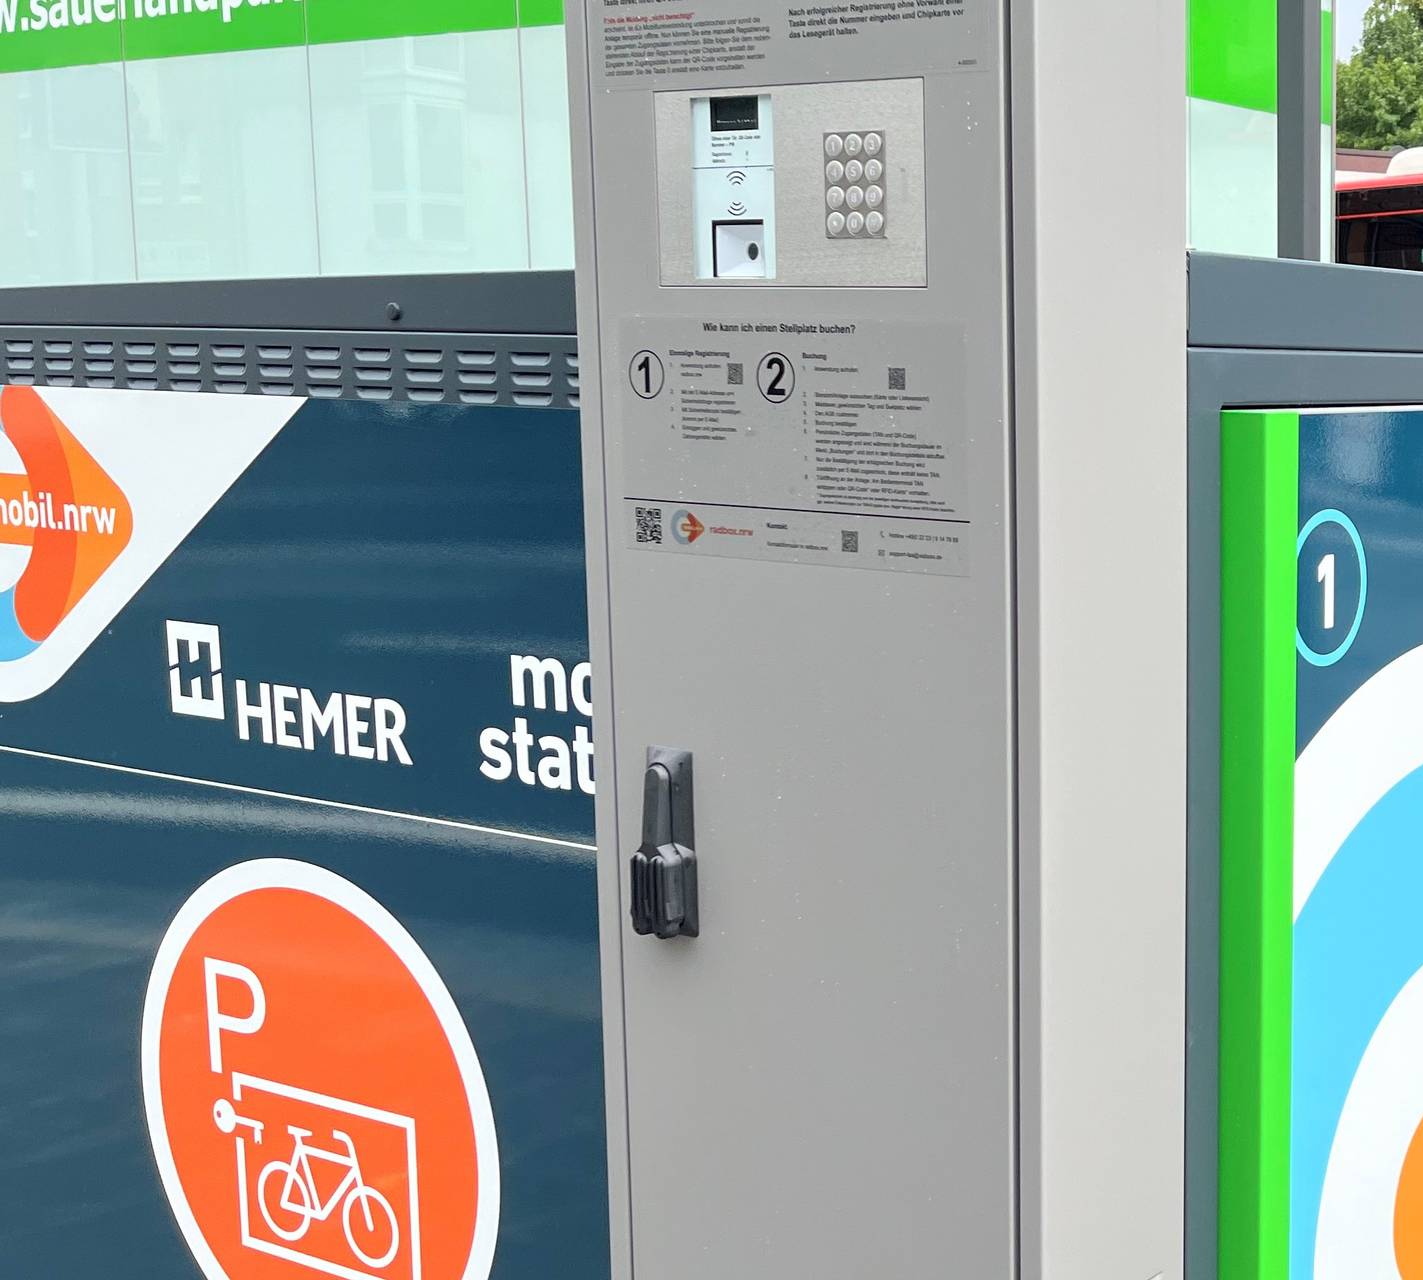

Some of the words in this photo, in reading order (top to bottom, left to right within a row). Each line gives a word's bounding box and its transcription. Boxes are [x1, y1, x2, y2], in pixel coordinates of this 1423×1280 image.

[789, 8, 806, 16] Nach
[850, 2, 896, 13] Registrierung
[839, 15, 868, 24] Nummer
[702, 322, 718, 332] Wie
[719, 322, 739, 332] kann
[740, 322, 754, 333] ich
[755, 322, 778, 333] einen
[779, 323, 818, 335] Stellplatz
[819, 324, 856, 334] buchen?
[638, 356, 651, 393] 1
[766, 357, 786, 396] 2
[1316, 553, 1336, 630] 1
[235, 679, 414, 766] HEMER
[204, 957, 267, 1073] P
